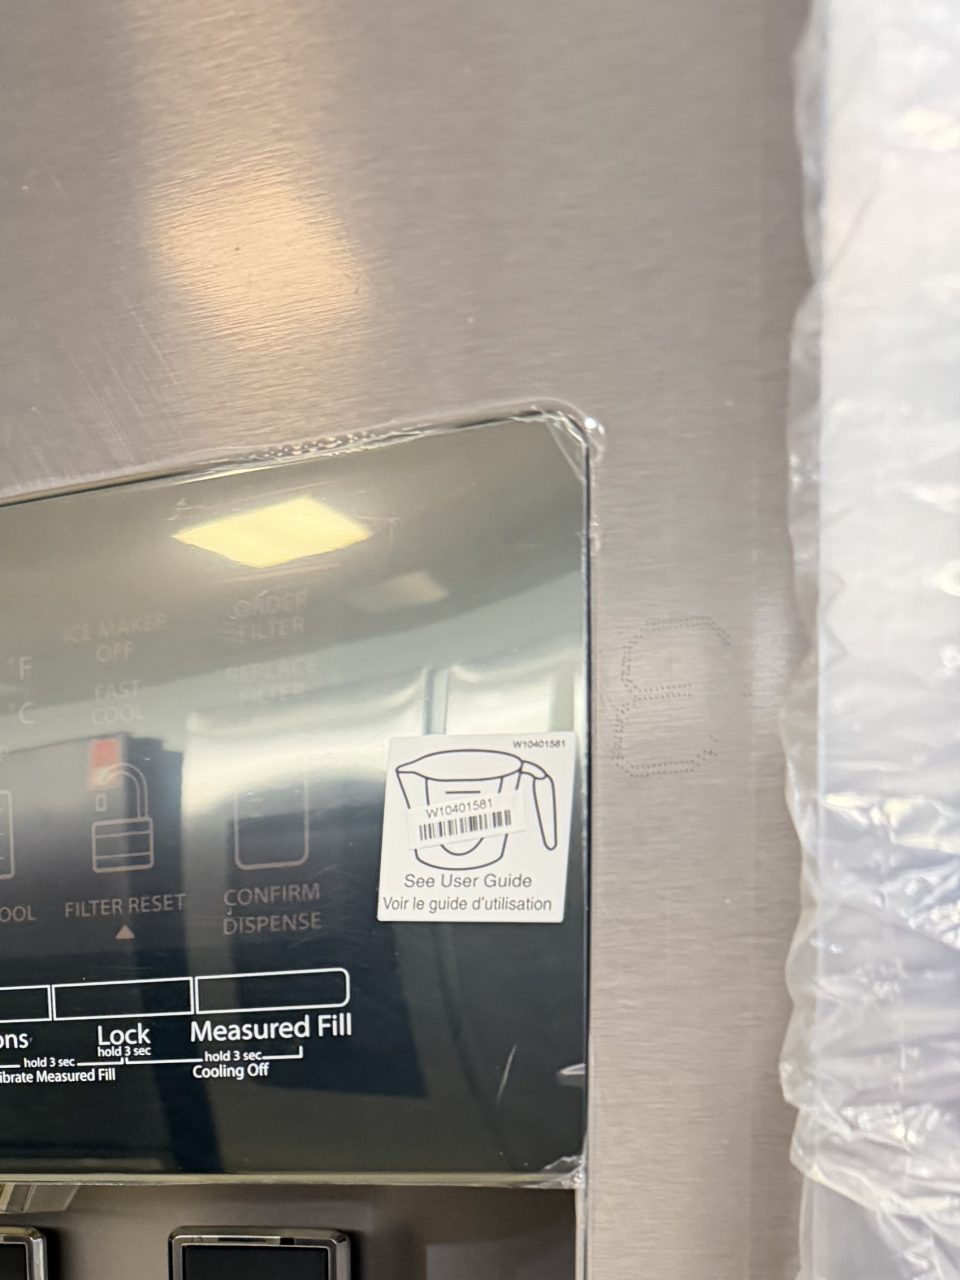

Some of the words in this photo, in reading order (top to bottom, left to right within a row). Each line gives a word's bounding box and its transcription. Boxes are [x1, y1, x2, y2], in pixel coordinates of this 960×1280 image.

[234, 588, 307, 618] ORDER
[63, 622, 92, 644] ICE
[97, 611, 169, 638] MAKER
[95, 640, 134, 663] OFF
[94, 678, 141, 701] FAST
[91, 702, 145, 726] COOL
[425, 797, 493, 820] W10401581
[403, 873, 436, 888] See
[440, 873, 479, 889] User
[483, 872, 533, 889] Guide
[64, 898, 123, 918] FILTER
[127, 892, 187, 914] RESET
[223, 882, 321, 907] CONFIRM
[383, 896, 408, 912] Voir
[412, 896, 425, 911] le
[429, 896, 468, 914] guide
[472, 895, 553, 912] d'utilisation
[222, 911, 323, 936] DISPENSE
[97, 1023, 151, 1047] Lock
[190, 1013, 311, 1043] Measured
[317, 1012, 353, 1038] Fill
[23, 1056, 48, 1069] hold
[50, 1056, 57, 1069] 3
[59, 1058, 76, 1068] sec
[97, 1045, 122, 1058] hold
[124, 1045, 131, 1057] 3
[133, 1046, 152, 1057] sec
[204, 1050, 230, 1063] hold
[233, 1050, 240, 1062] 3
[243, 1051, 262, 1062] sec
[36, 1069, 95, 1084] Measured
[98, 1068, 116, 1082] Fill
[192, 1063, 244, 1081] Cooling
[248, 1062, 270, 1078] Off
